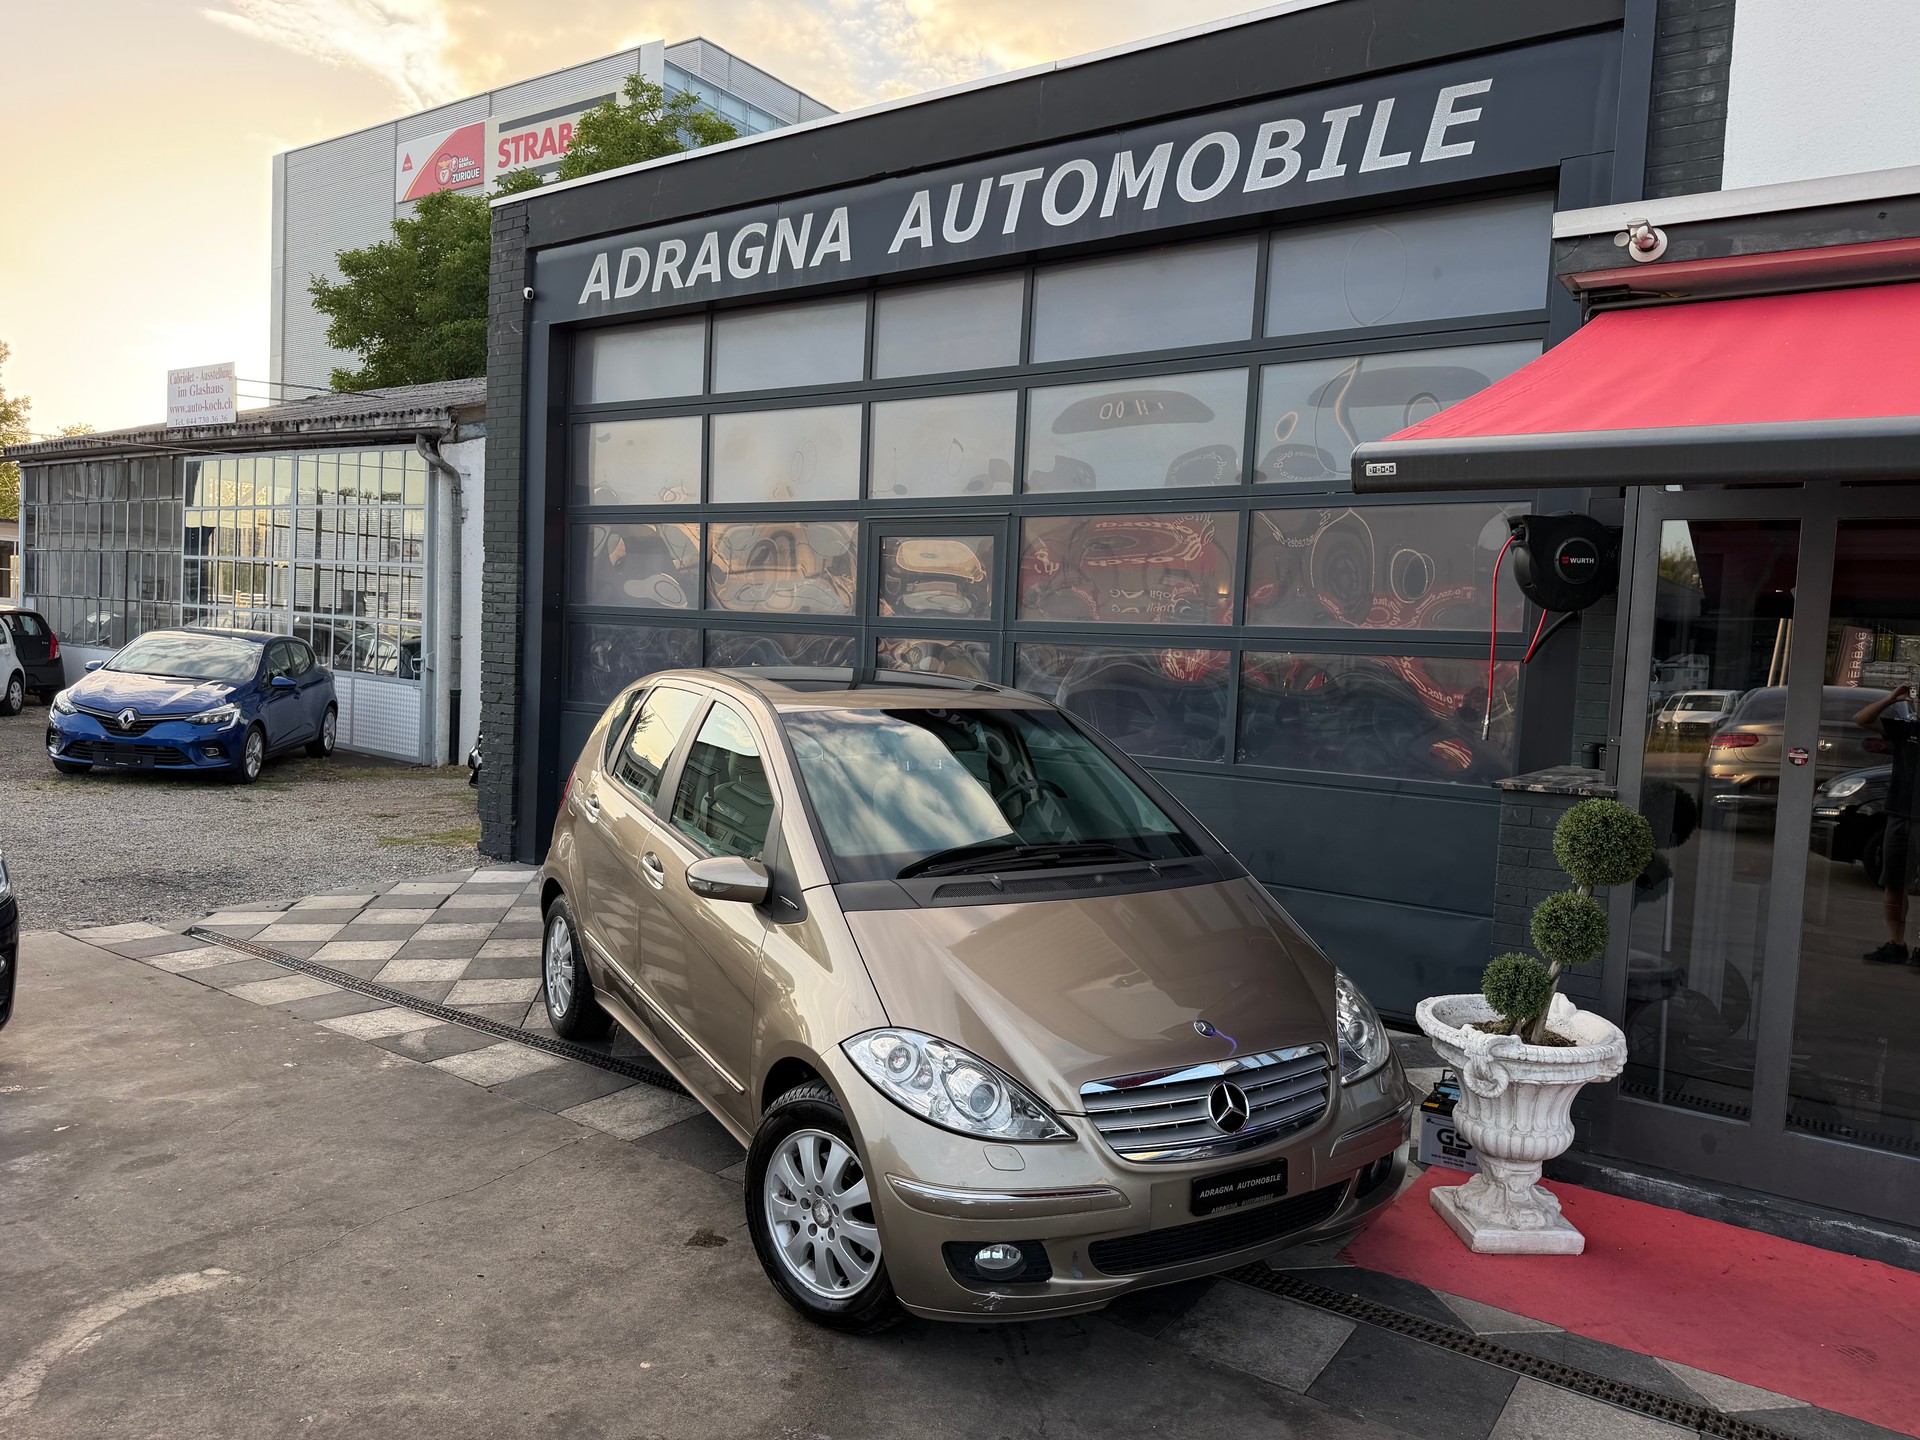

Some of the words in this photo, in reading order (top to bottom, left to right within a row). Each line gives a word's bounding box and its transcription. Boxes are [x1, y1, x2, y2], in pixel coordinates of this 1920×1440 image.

[452, 168, 480, 183] ZURIQUE
[577, 205, 851, 306] ADRAGNA
[888, 79, 1494, 254] AUTOMOBILE
[169, 371, 195, 385] Cabriolet
[200, 367, 233, 381] Ausstellung
[177, 387, 187, 398] im
[189, 383, 224, 396] Glashaus
[169, 397, 233, 414] www.auto-koch.ch
[186, 417, 197, 425] 044
[198, 416, 210, 424] 730
[211, 415, 218, 423] 36
[220, 414, 228, 422] 36
[1437, 1128, 1473, 1150] GS
[1199, 1184, 1234, 1199] ADRAGNA
[1236, 1173, 1282, 1190] AUTOMOBILE
